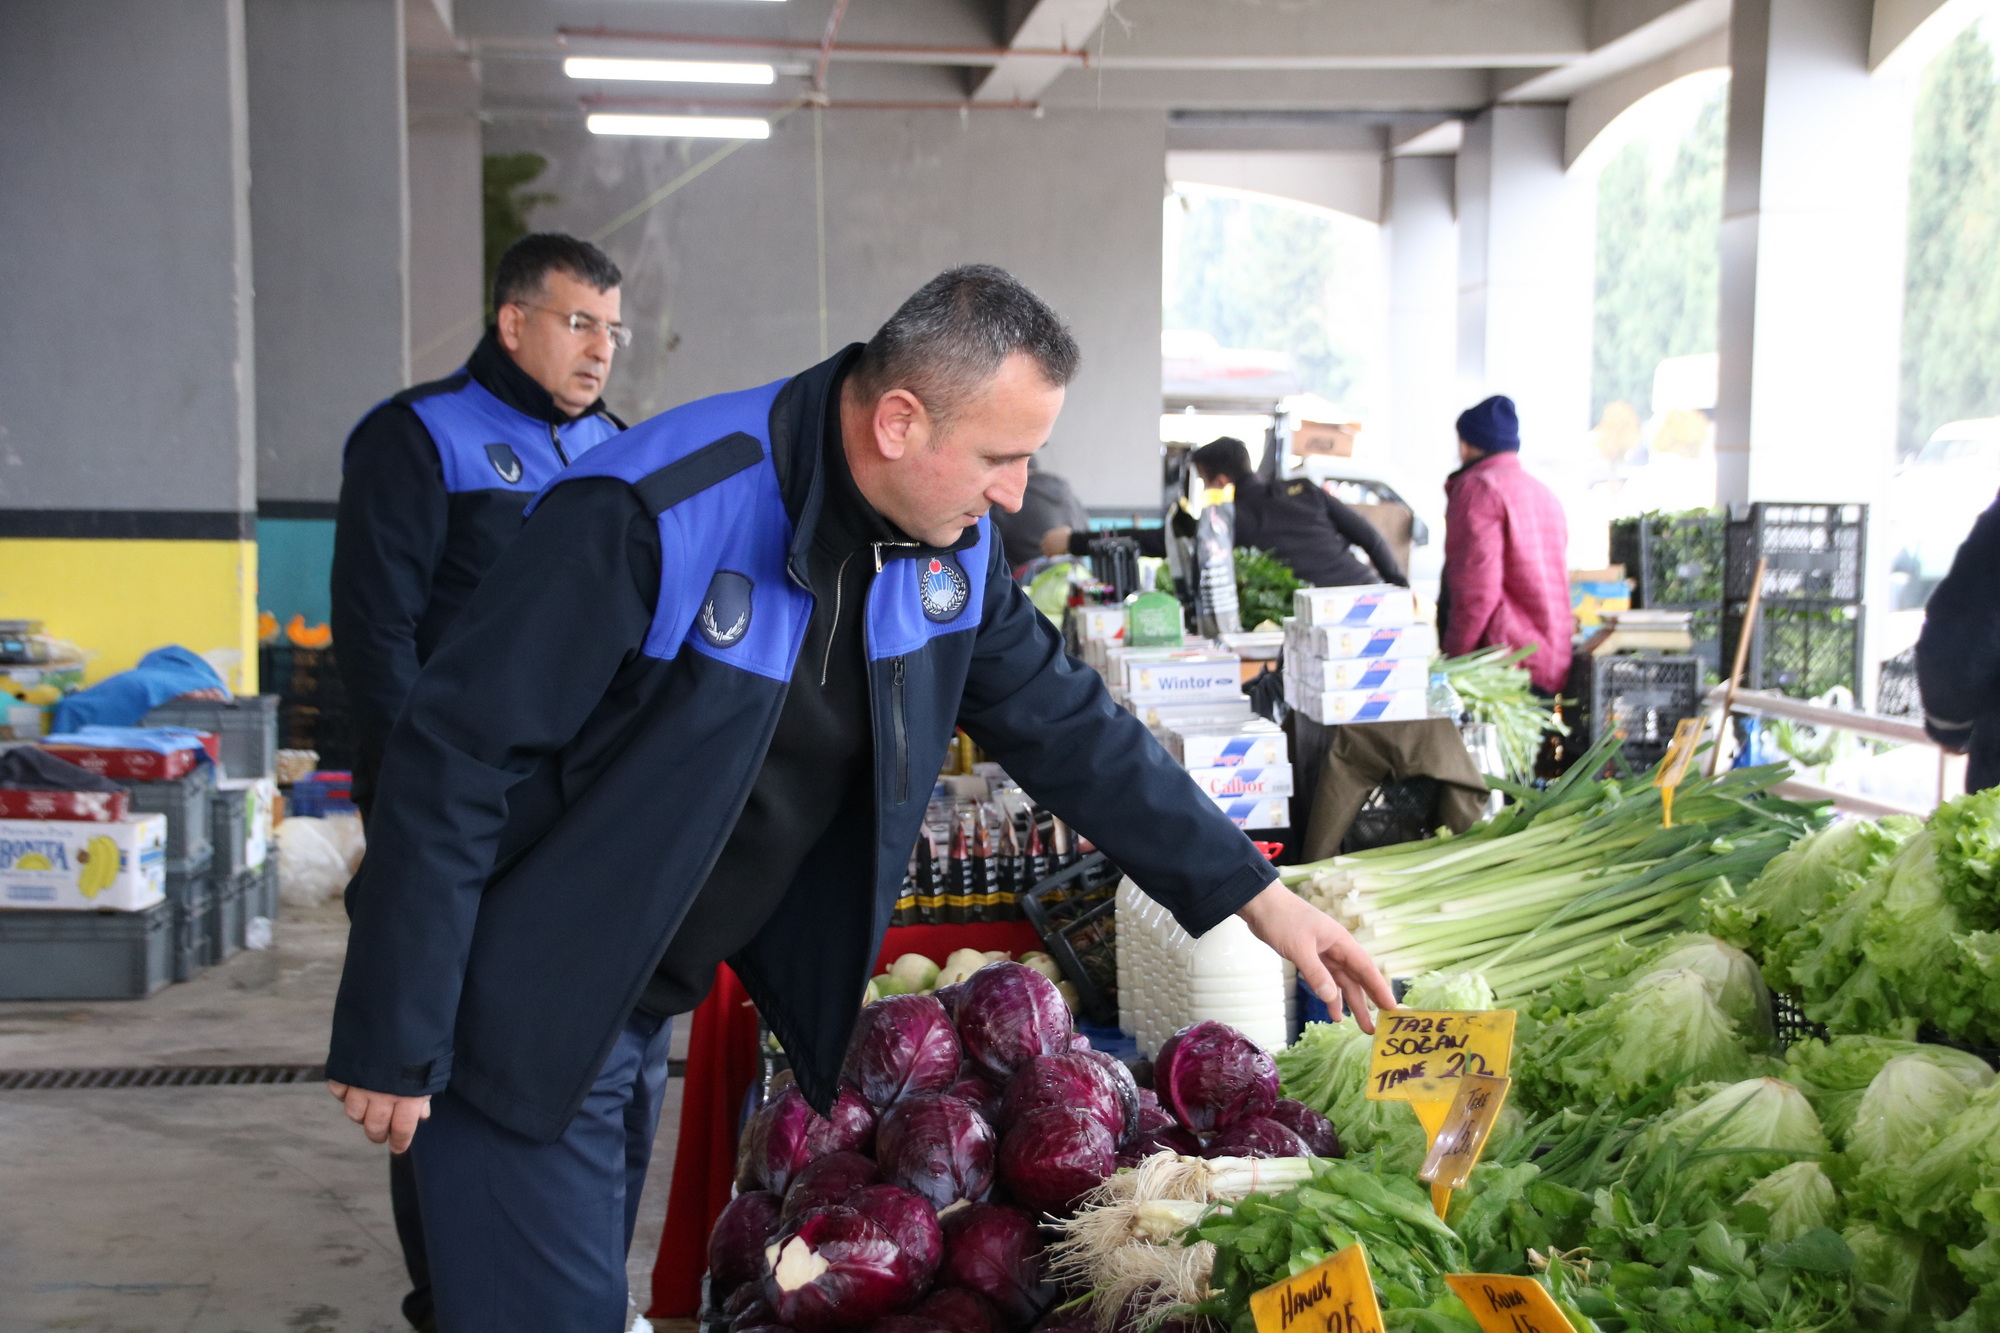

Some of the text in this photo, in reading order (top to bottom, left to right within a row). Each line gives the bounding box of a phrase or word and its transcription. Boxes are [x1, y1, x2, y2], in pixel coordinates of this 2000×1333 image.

[1158, 676, 1212, 691] Wintor
[1210, 776, 1265, 794] Calbor
[1388, 1016, 1453, 1034] TAZE
[1375, 1060, 1428, 1093] TANE
